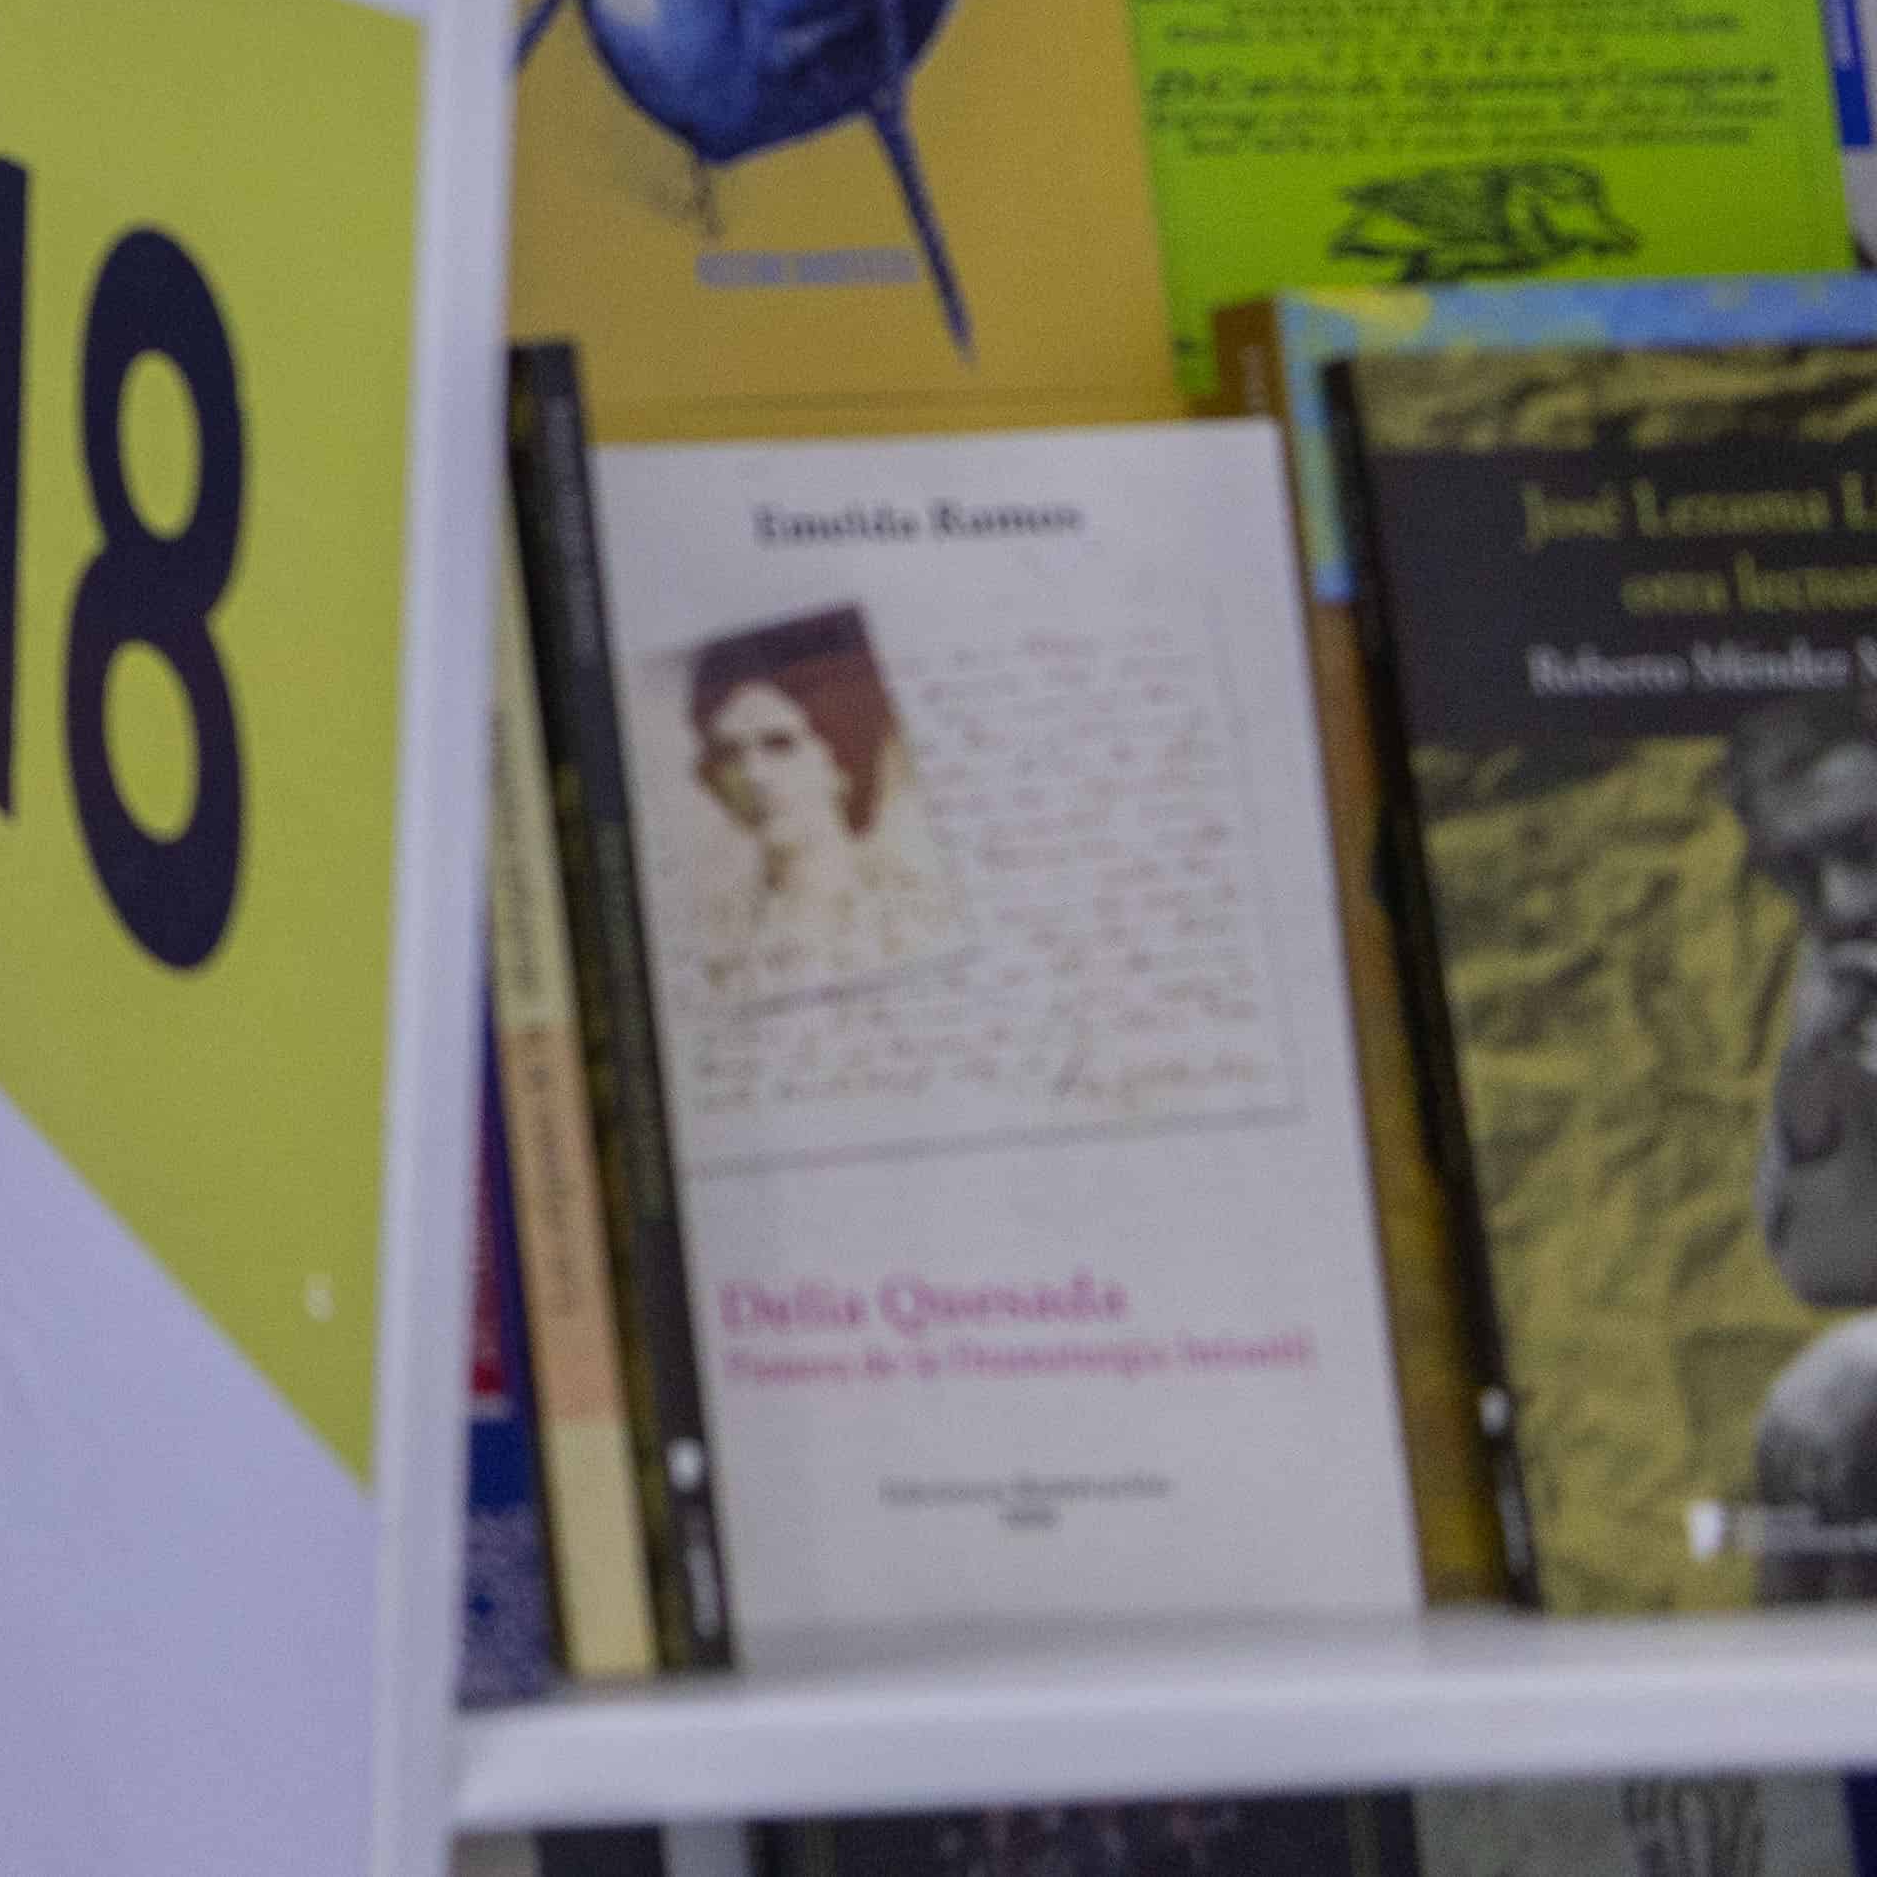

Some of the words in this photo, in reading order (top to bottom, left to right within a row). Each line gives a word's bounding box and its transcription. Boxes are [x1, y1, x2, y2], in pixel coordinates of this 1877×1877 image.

[928, 495, 1087, 539] Ramos
[1521, 479, 1623, 553] José
[1632, 476, 1833, 540] Lezama
[1526, 641, 1690, 700] Roberto
[719, 1279, 867, 1335] Delia
